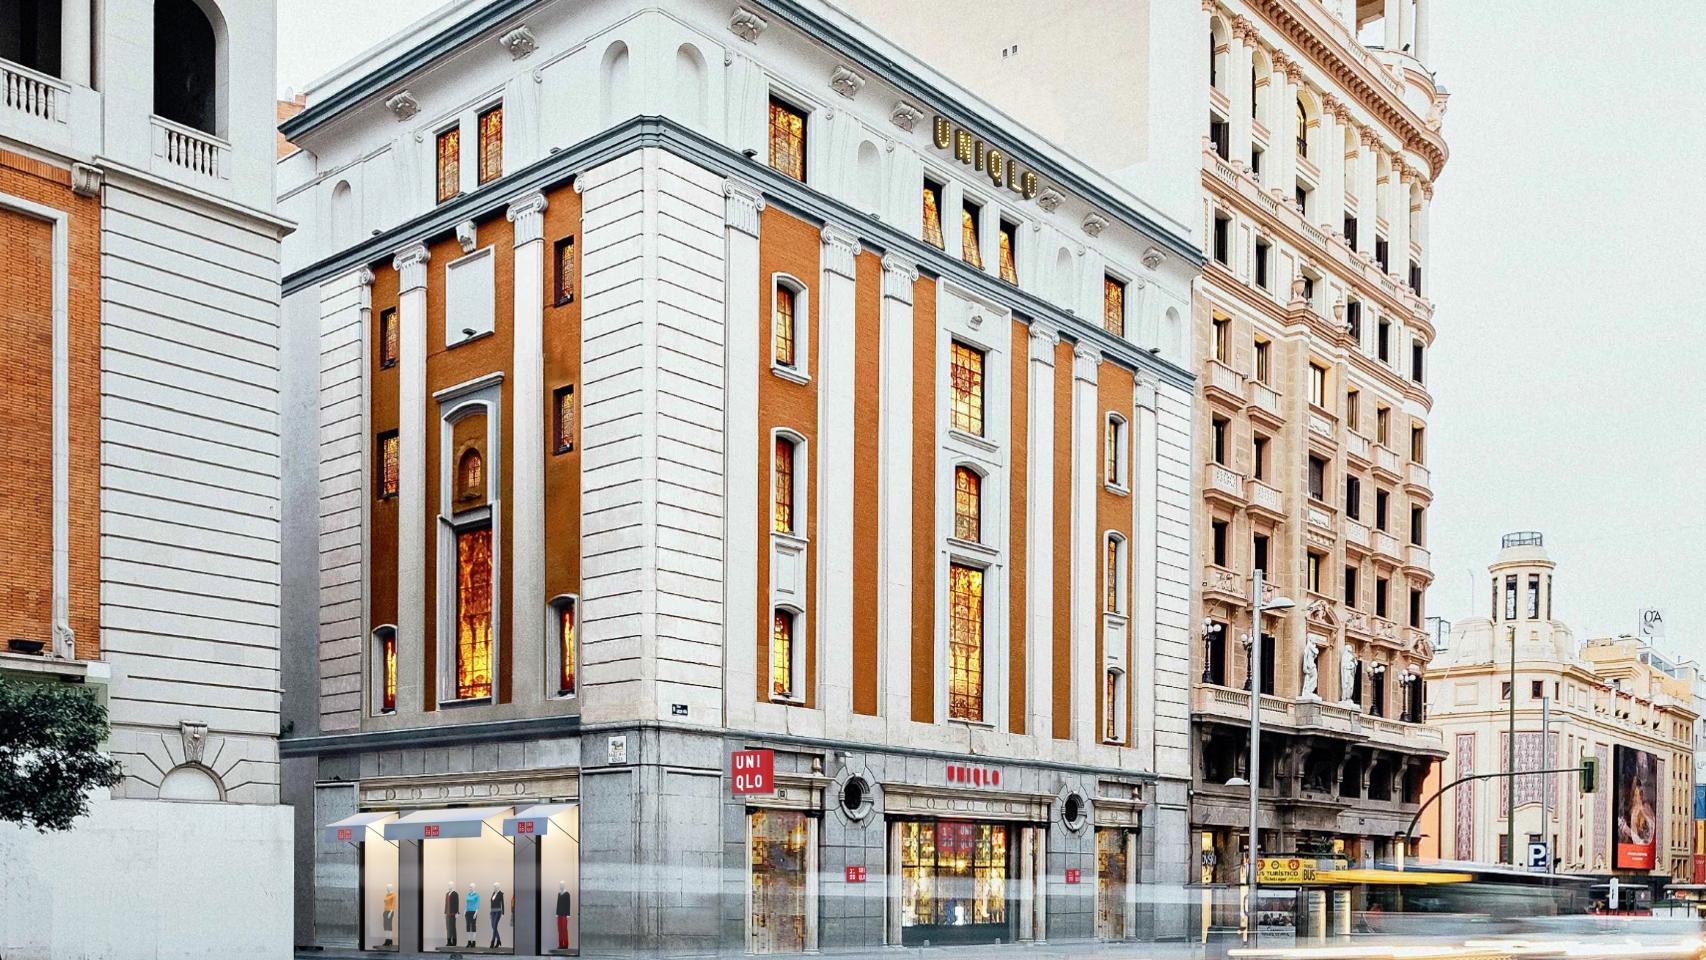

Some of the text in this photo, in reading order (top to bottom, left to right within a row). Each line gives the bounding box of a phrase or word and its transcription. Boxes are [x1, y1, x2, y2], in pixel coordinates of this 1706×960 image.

[933, 115, 1037, 200] UNIQLO
[736, 755, 760, 769] UNI
[736, 774, 763, 791] QLO
[947, 765, 999, 787] UNIQLO
[1303, 869, 1316, 881] BUS
